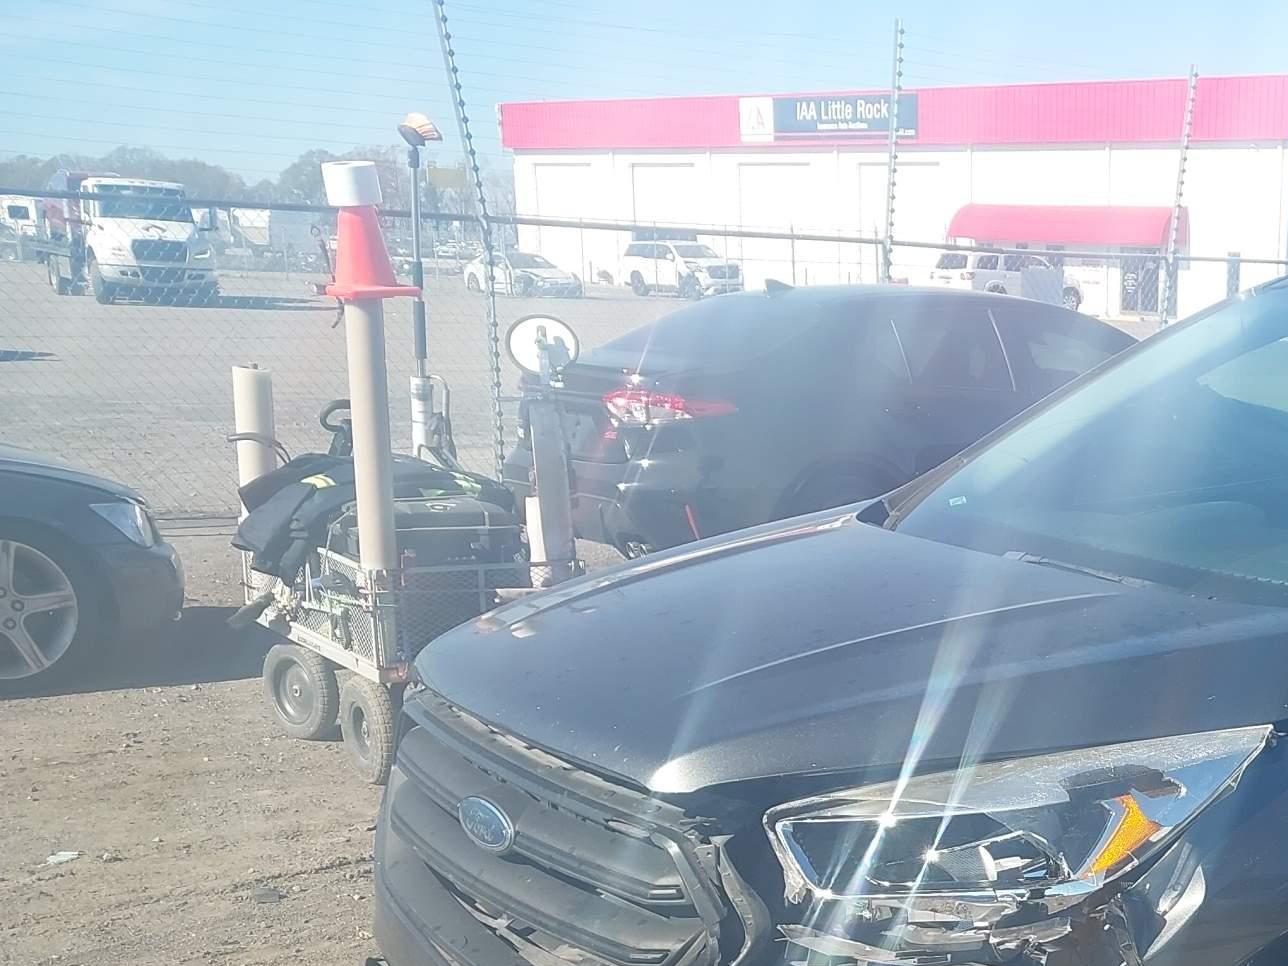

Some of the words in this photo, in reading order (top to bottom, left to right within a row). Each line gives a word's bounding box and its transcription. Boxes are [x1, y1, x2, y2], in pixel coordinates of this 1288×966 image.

[796, 101, 817, 120] IAA
[821, 100, 852, 120] Little
[856, 98, 889, 119] Rock
